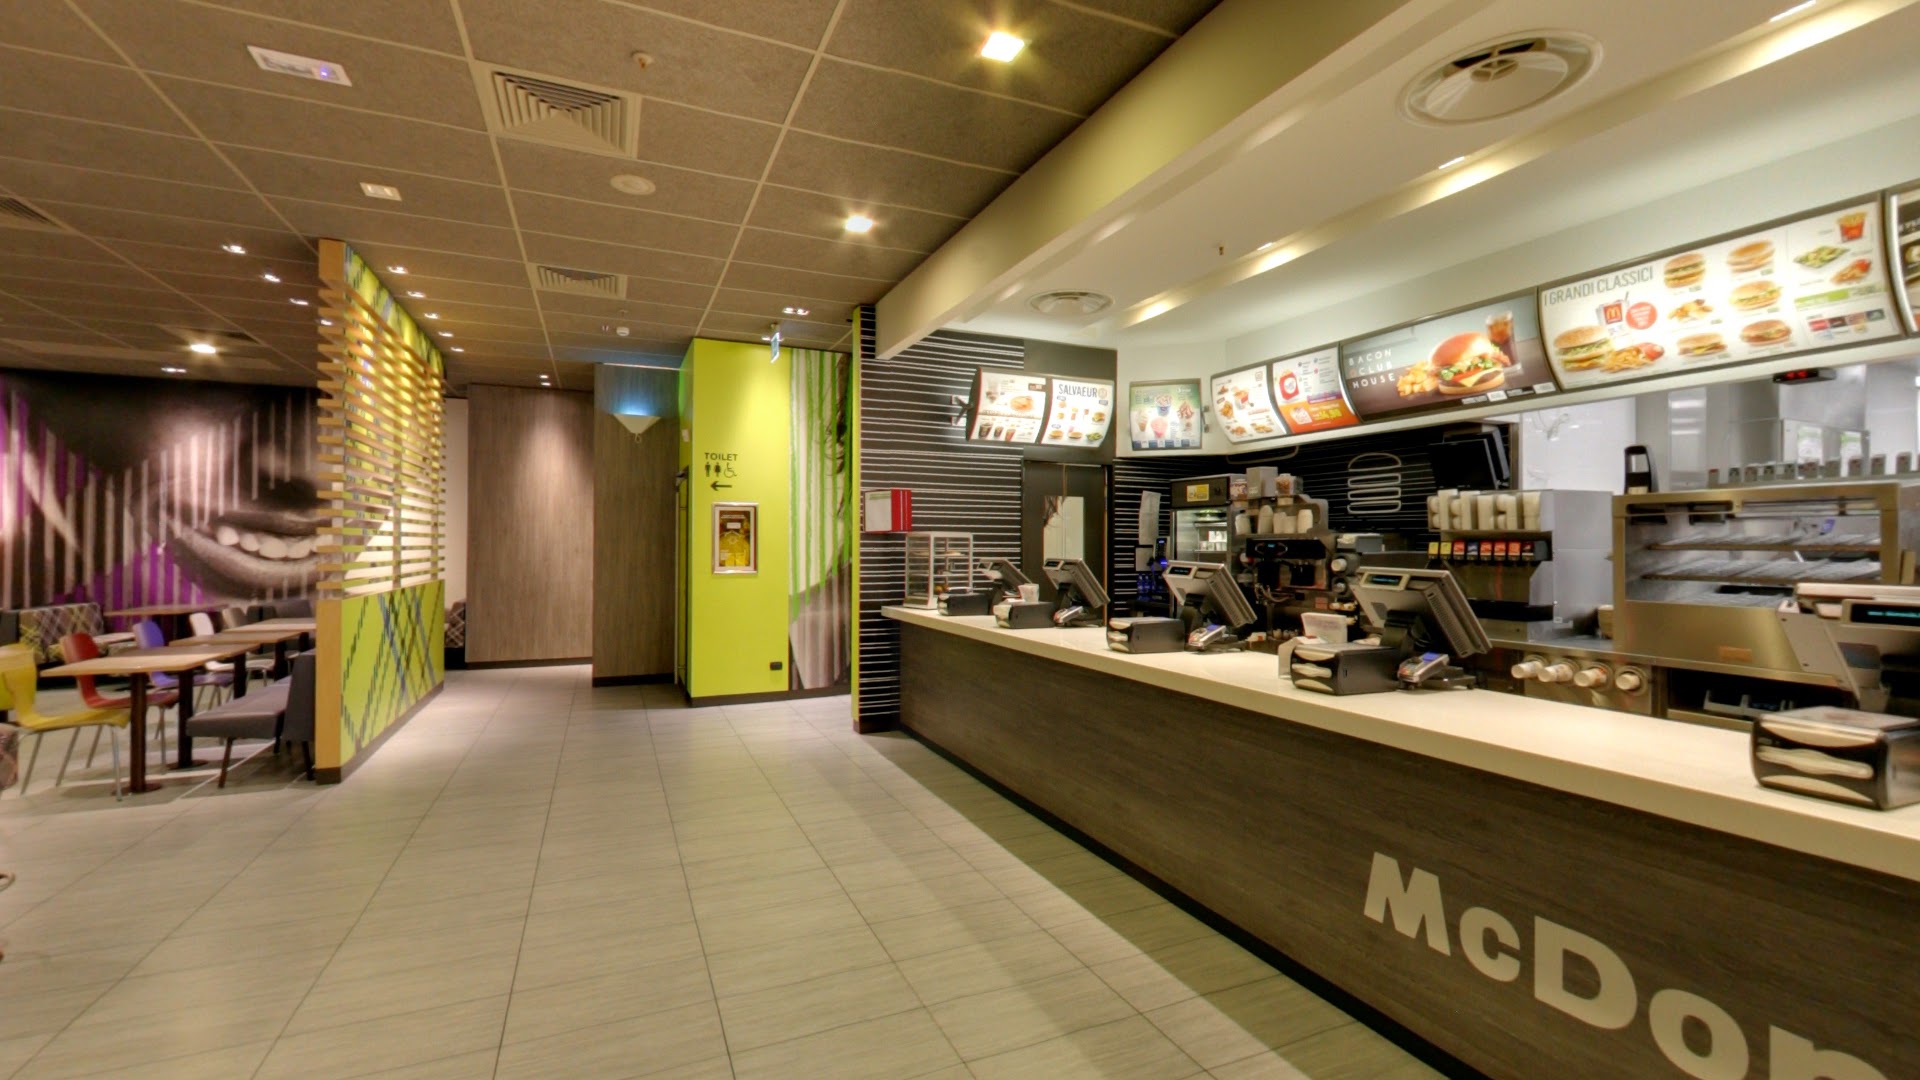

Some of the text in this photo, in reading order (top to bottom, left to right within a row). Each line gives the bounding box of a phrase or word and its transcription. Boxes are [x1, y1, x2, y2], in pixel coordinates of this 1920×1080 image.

[1549, 282, 1595, 305] GRANDI
[1597, 265, 1654, 293] CLASSICI
[1348, 348, 1392, 366] BACON
[1352, 372, 1396, 389] HOUSE
[704, 452, 738, 461] TOILET
